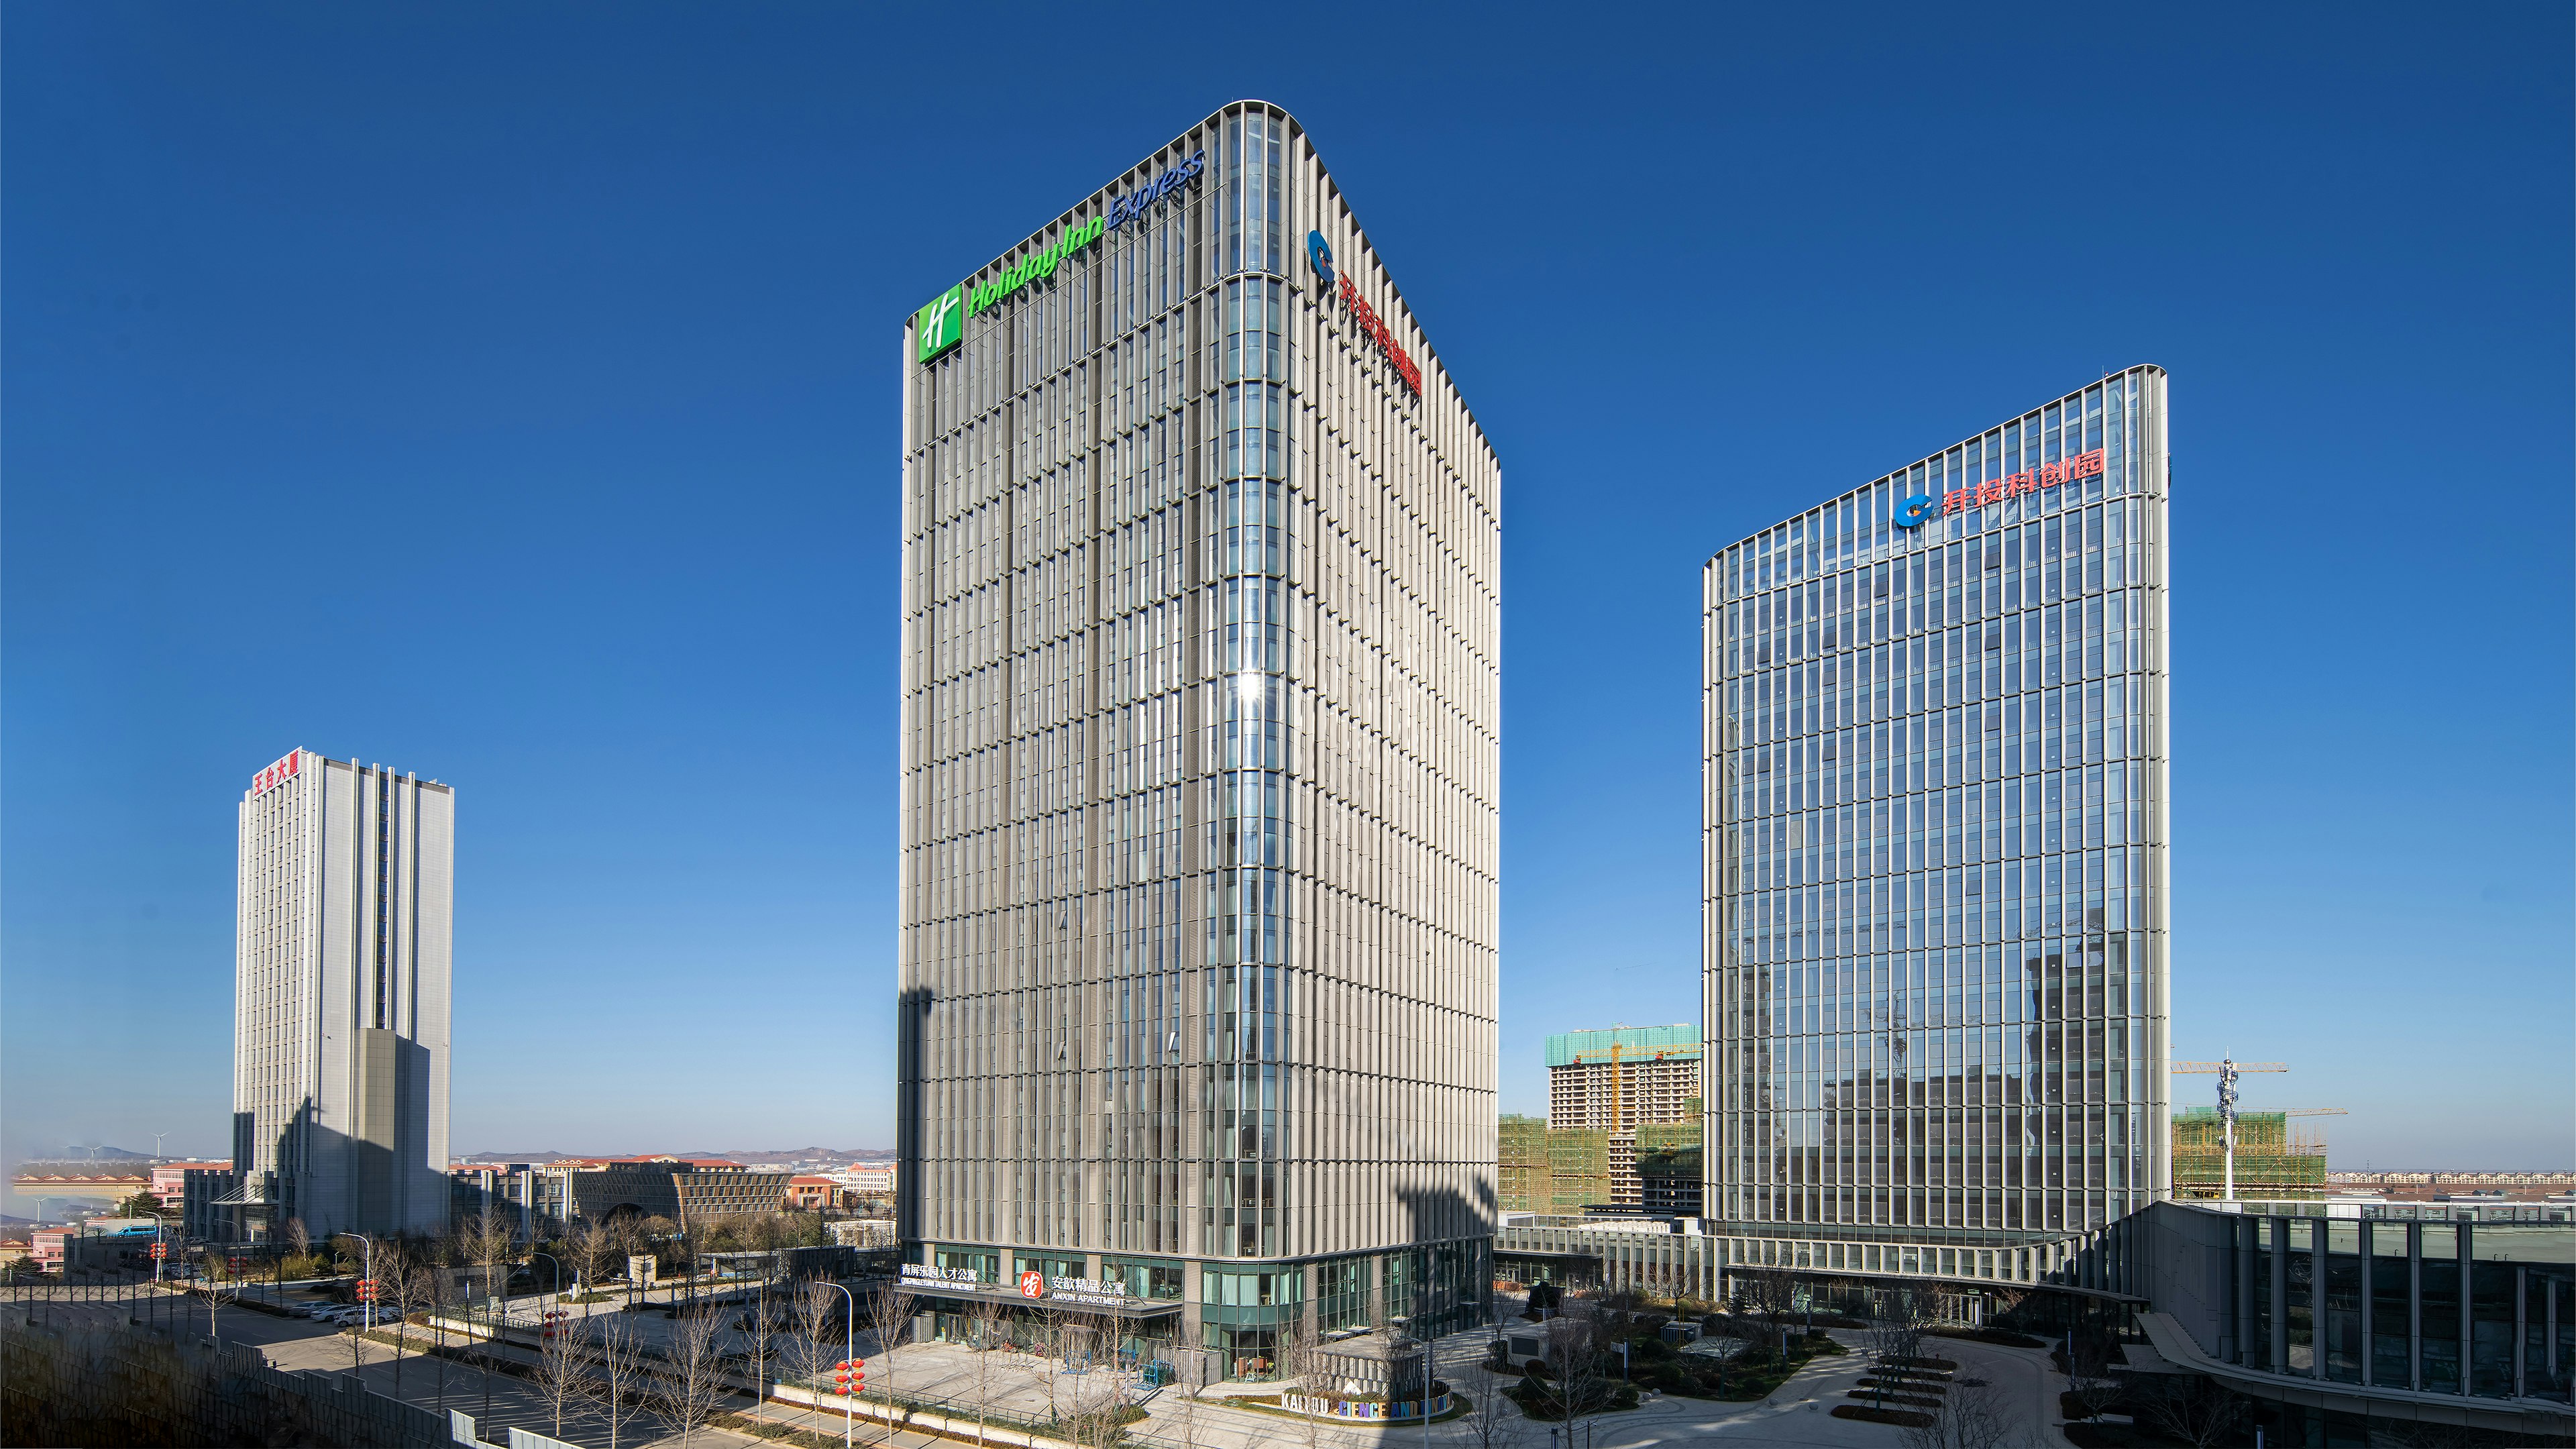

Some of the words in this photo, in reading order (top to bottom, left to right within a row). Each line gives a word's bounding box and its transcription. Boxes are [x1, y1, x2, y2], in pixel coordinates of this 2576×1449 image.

[967, 242, 1060, 319] Holiday
[1062, 215, 1104, 259] Inn
[1108, 149, 1205, 230] Express
[1339, 270, 1422, 397] 开投科创园
[1941, 447, 2104, 517] 开投科创园
[254, 749, 299, 797] 王台大厦
[901, 1263, 978, 1283] 青屏乐园人才公寓
[934, 1281, 950, 1289] TALENT
[950, 1282, 977, 1291] APARTMENT
[1051, 1275, 1126, 1297] 安歆精品公寓
[1077, 1294, 1126, 1307] APARTMENT
[1333, 1400, 1386, 1419] CIENCE
[1391, 1401, 1418, 1418] AND
